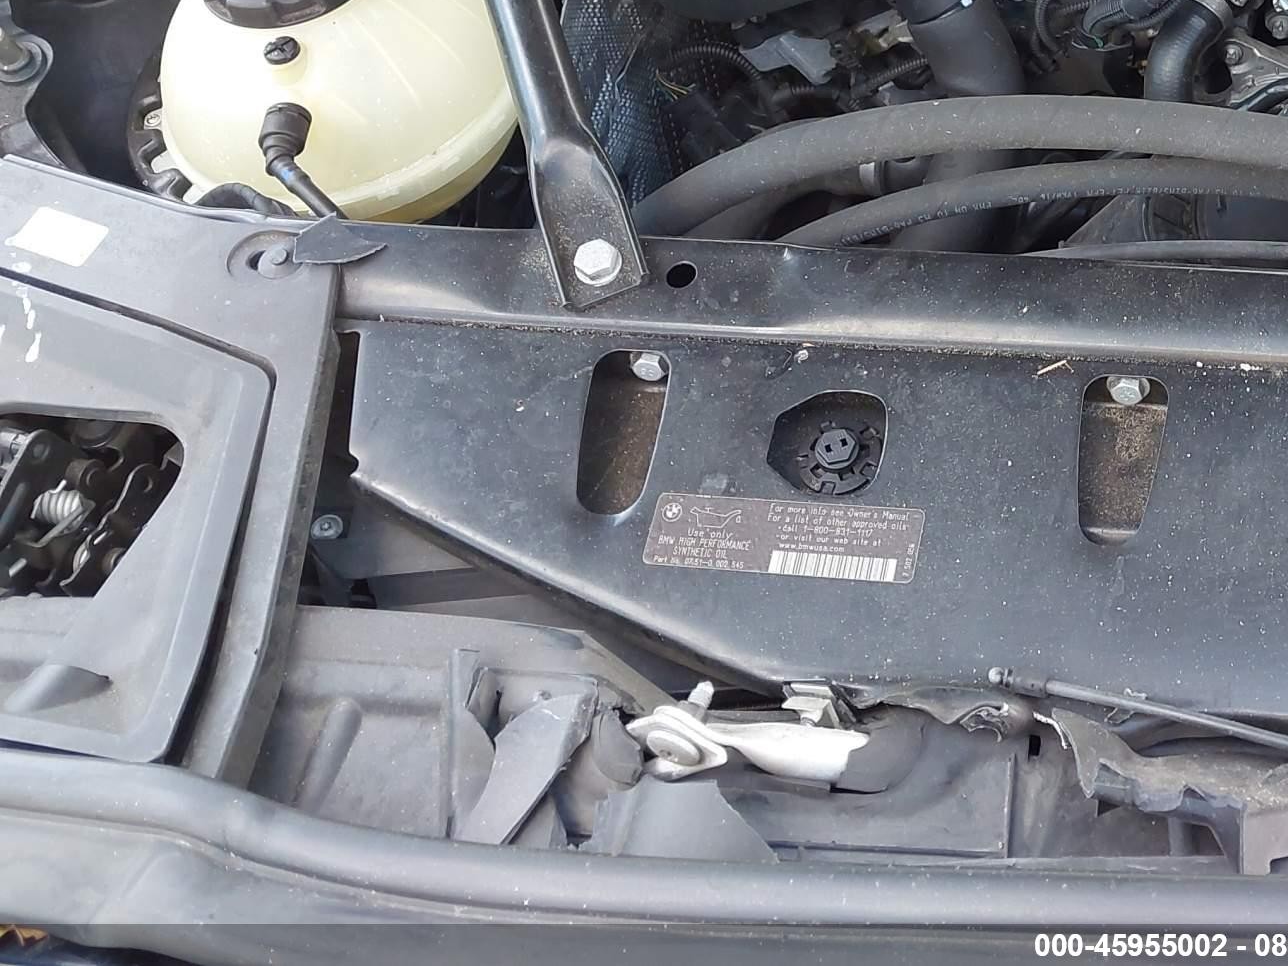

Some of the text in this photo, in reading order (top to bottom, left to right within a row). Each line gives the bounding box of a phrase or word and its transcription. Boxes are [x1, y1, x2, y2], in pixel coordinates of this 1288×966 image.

[769, 503, 784, 512] For
[787, 506, 806, 514] more
[882, 510, 910, 521] Manual
[767, 513, 781, 522] For
[795, 514, 809, 524] list
[813, 515, 823, 525] of
[826, 517, 848, 527] other
[851, 521, 887, 530] approved
[687, 527, 733, 541] Use only
[834, 537, 848, 545] web
[658, 534, 752, 551] BMW HIGH PERFORMANCE
[672, 545, 713, 558] SYNTHETIC
[653, 555, 668, 563] Part
